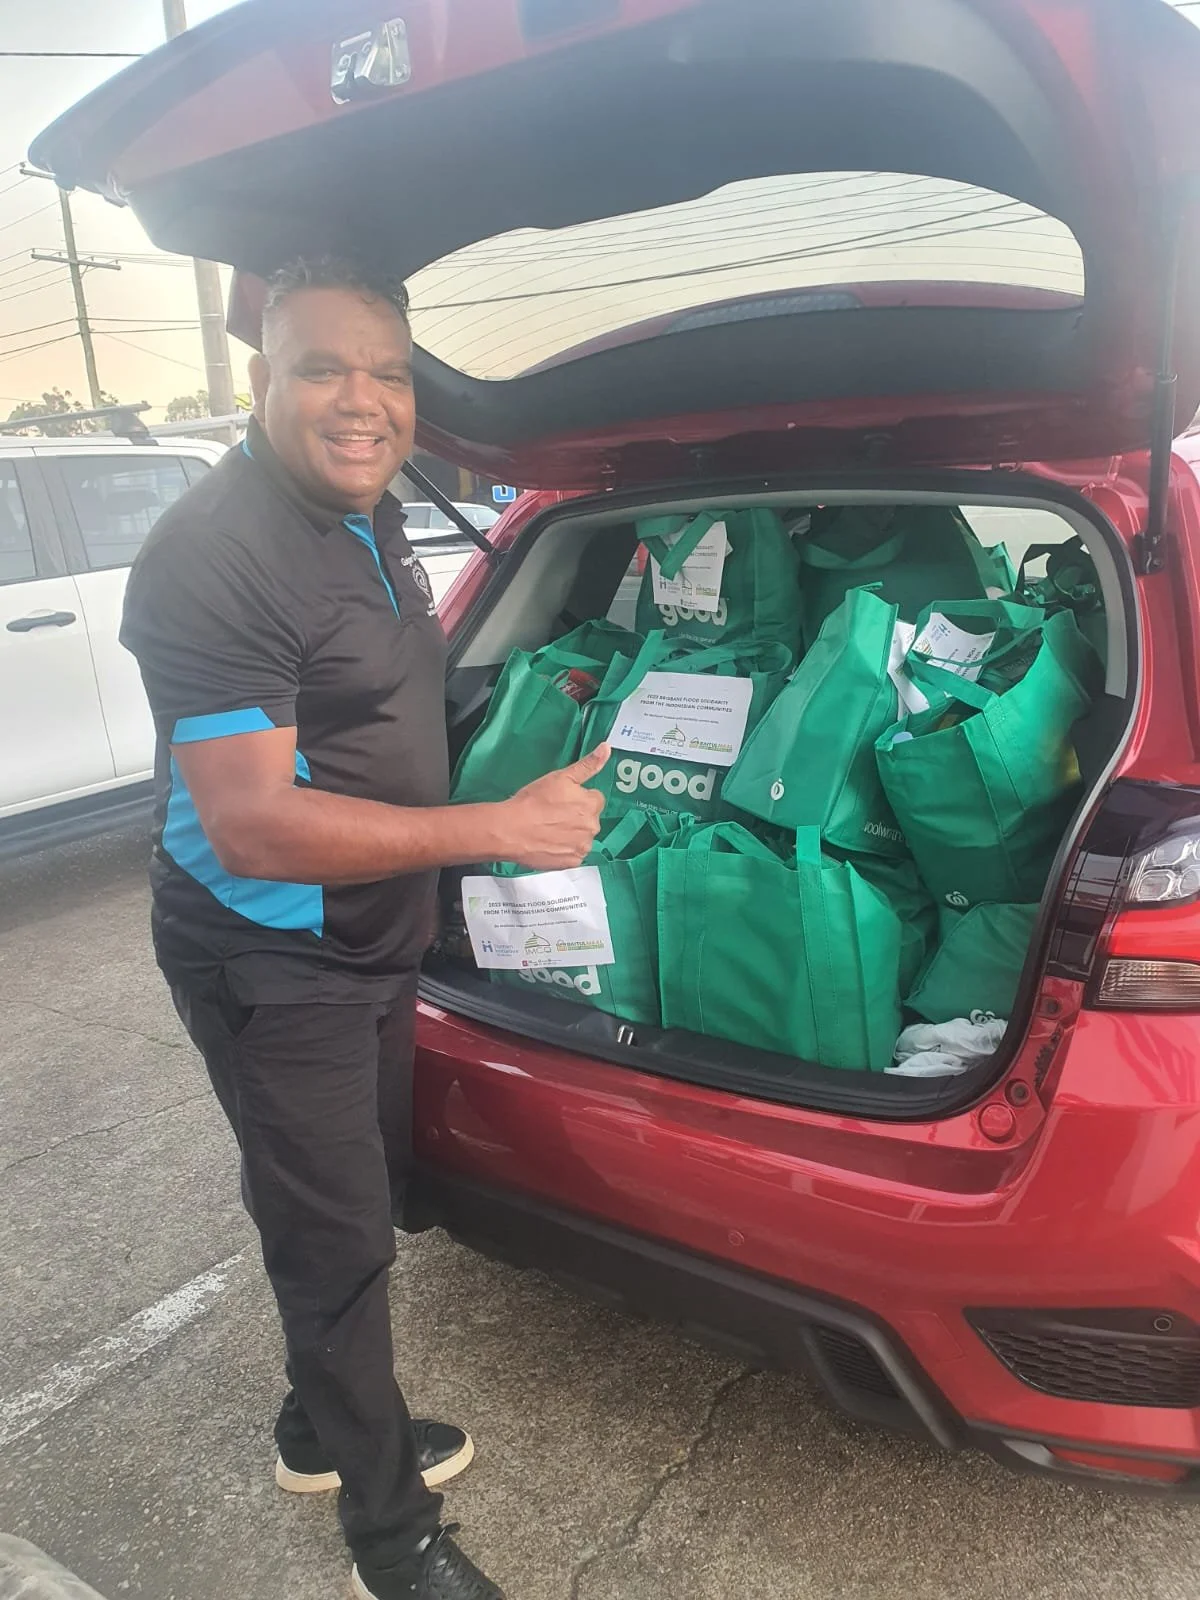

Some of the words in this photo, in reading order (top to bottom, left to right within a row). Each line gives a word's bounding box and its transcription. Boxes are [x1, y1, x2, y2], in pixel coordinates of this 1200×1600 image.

[616, 758, 717, 801] good
[547, 895, 580, 906] SOLIDARITY
[545, 902, 588, 913] COMMUNITIES
